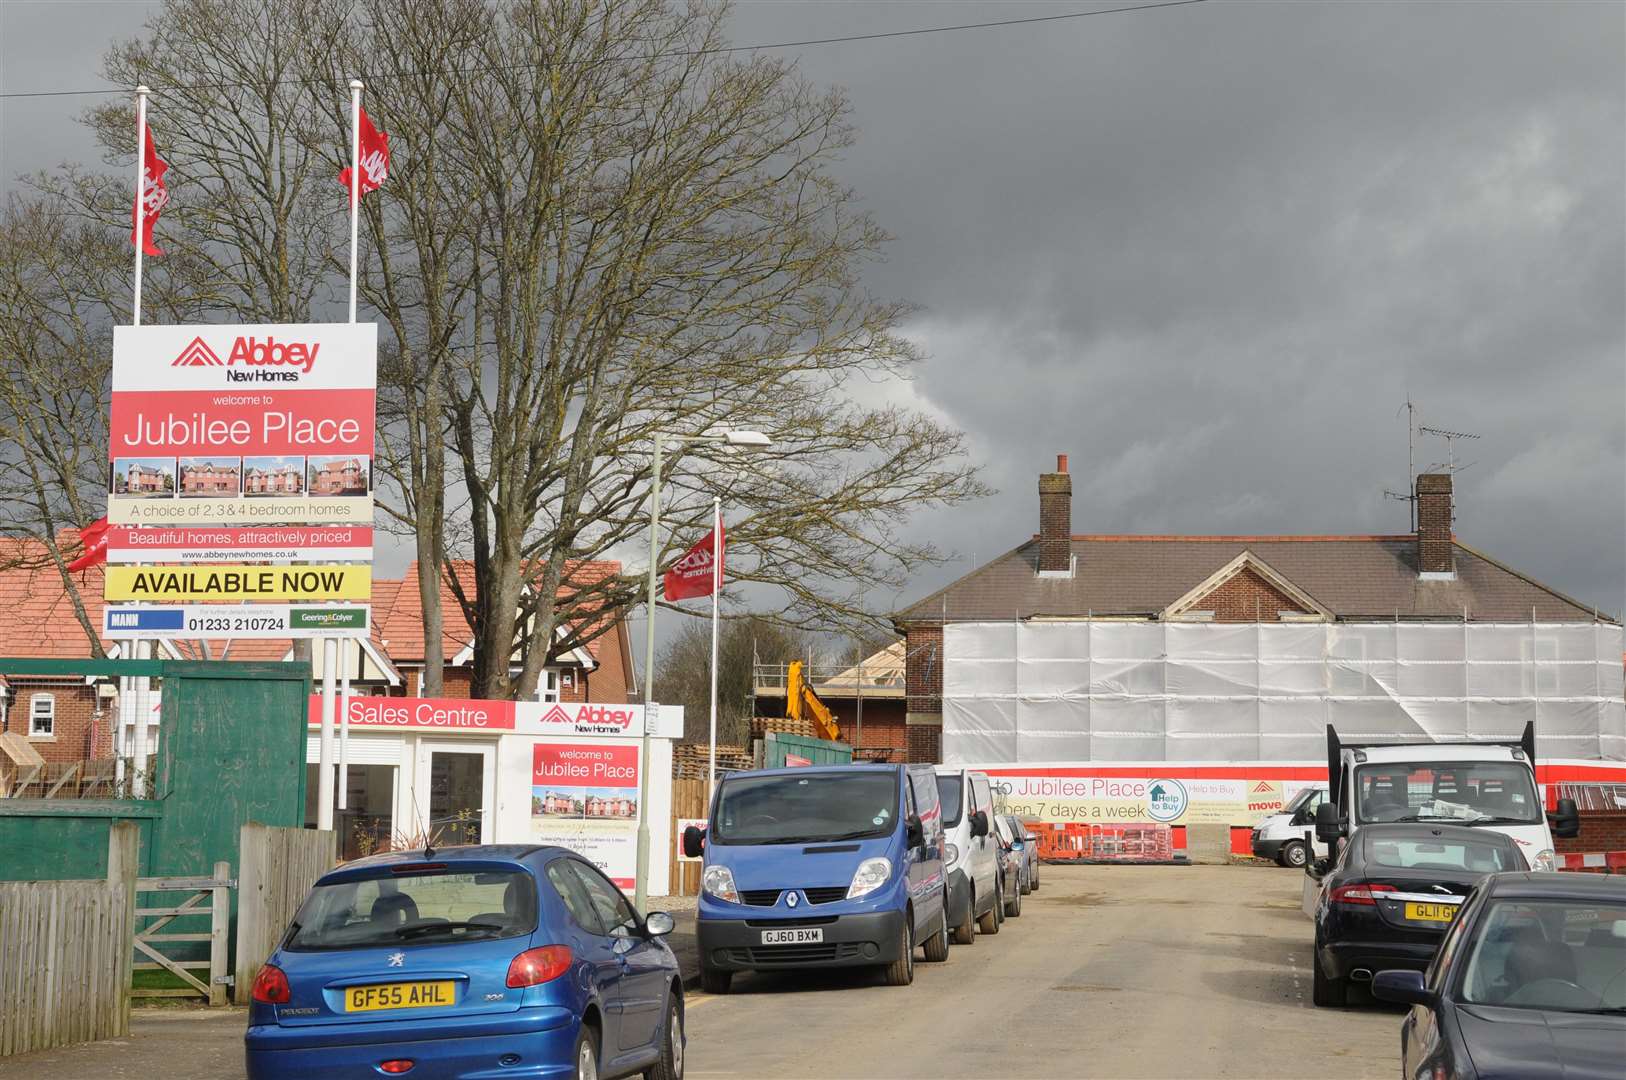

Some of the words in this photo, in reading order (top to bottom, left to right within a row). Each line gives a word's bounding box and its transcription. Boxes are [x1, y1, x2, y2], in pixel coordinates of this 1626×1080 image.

[227, 336, 320, 373] Abbey
[227, 370, 254, 382] New
[256, 369, 298, 382] Homes
[213, 395, 260, 406] welcome
[262, 395, 272, 406] to
[124, 413, 250, 446] Jubilee
[263, 412, 360, 444] Place
[130, 506, 140, 516] A
[144, 504, 185, 517] choice
[188, 504, 201, 516] of
[250, 504, 304, 516] bedroom
[309, 504, 350, 516] homes
[128, 532, 184, 544] Beautiful
[188, 532, 234, 545] homes,
[238, 531, 306, 546] attractively
[310, 530, 352, 544] priced
[182, 550, 298, 560] www.abbeynewhomes.co.uk
[132, 572, 274, 594] AVAILABLE
[282, 572, 344, 592] NOW
[112, 614, 138, 626] MANN
[189, 619, 232, 631] 01233
[234, 618, 284, 630] 210724
[349, 702, 409, 725] Sales
[416, 704, 488, 726] Centre
[575, 706, 634, 729] Abbey
[575, 725, 592, 733] New
[593, 726, 620, 734] Homes
[560, 751, 602, 760] welcome
[604, 752, 614, 760] to
[536, 762, 590, 778] Jubilee
[594, 764, 635, 778] Place
[1018, 778, 1086, 796] Jubilee
[1092, 779, 1145, 797] Place
[1220, 786, 1235, 795] Buy
[1158, 794, 1179, 804] Help
[1248, 801, 1282, 810] move
[1050, 803, 1087, 820] days
[1091, 808, 1100, 817] a
[1106, 804, 1146, 818] week
[1163, 804, 1179, 812] Buy
[766, 932, 794, 942] GJ60
[797, 930, 818, 941] BXM
[352, 986, 403, 1008] GF55
[408, 984, 446, 1004] AHL
